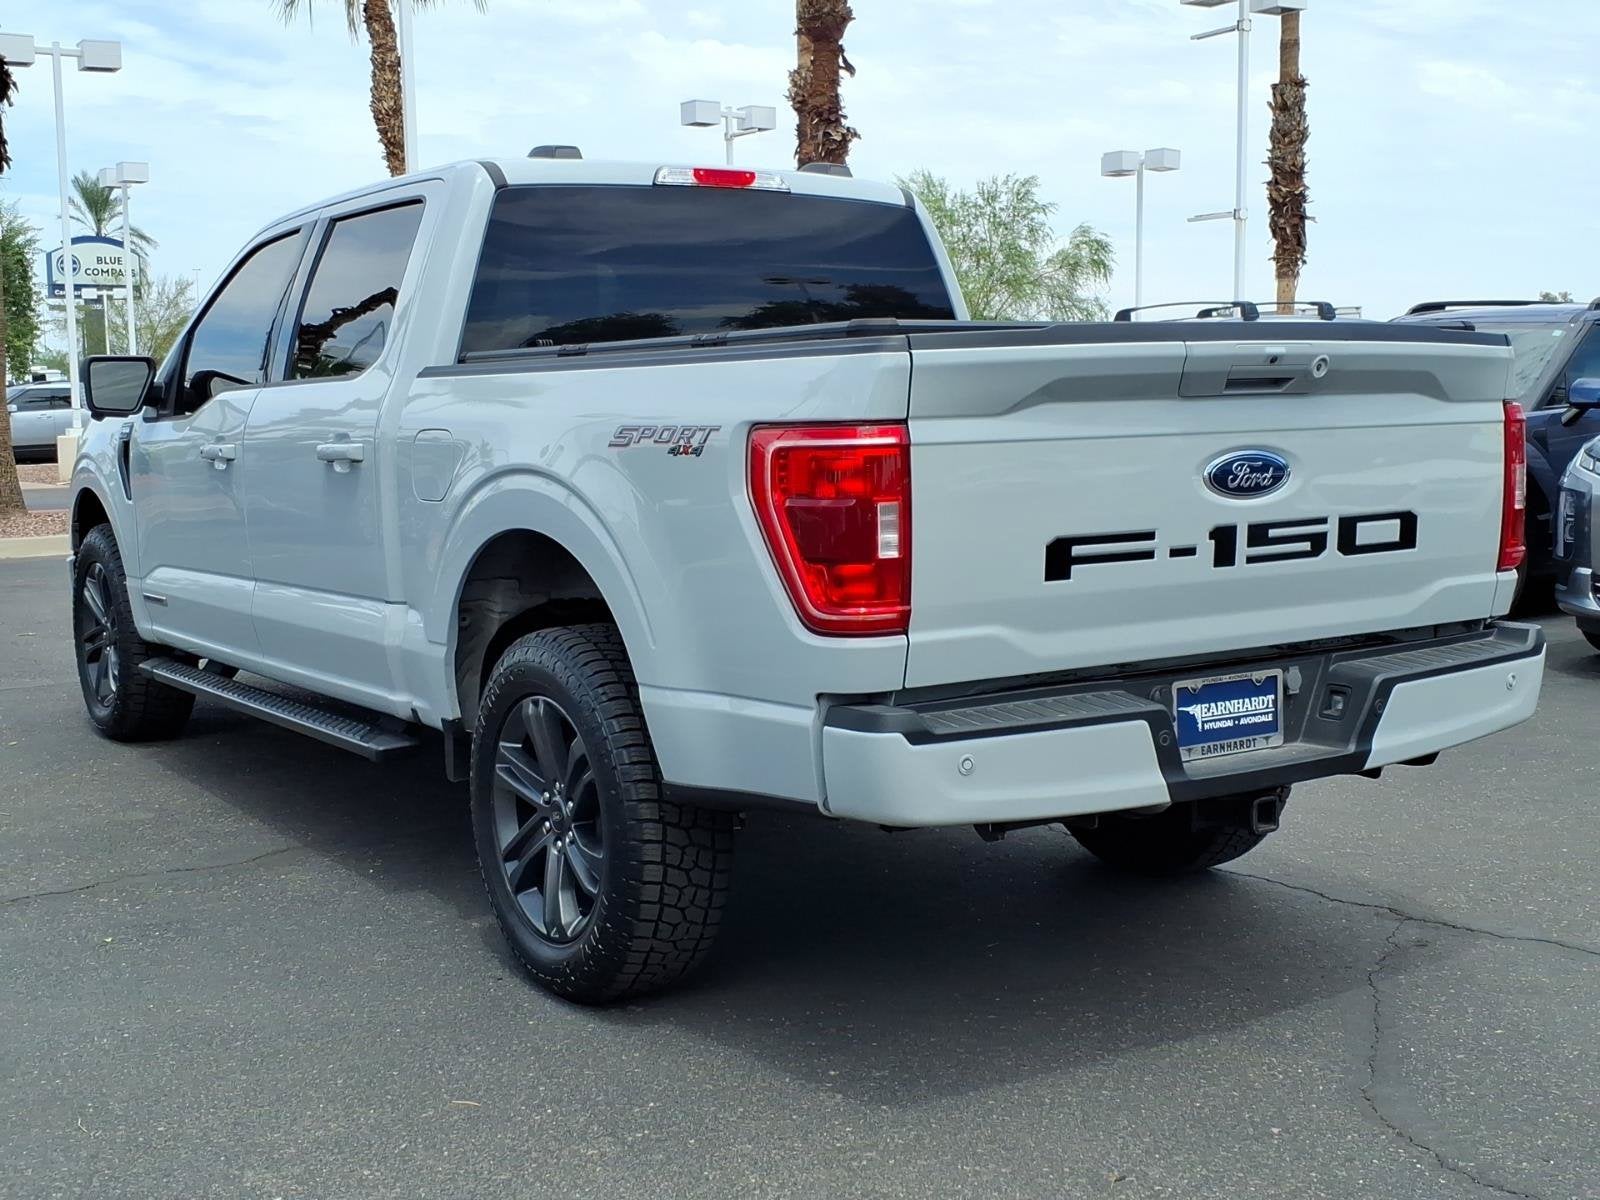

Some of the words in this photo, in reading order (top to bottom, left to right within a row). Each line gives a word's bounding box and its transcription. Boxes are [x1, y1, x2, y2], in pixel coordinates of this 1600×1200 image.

[96, 256, 123, 265] BLUE
[84, 268, 136, 277] COMPAS
[607, 425, 722, 448] SPORT
[1227, 460, 1275, 488] Ford
[1044, 510, 1419, 582] F-150
[1201, 694, 1275, 717] EARNHARDT
[1204, 719, 1234, 731] HYUNDAI
[1239, 713, 1273, 726] AVONDALE
[1201, 737, 1258, 756] EARNHARDT
